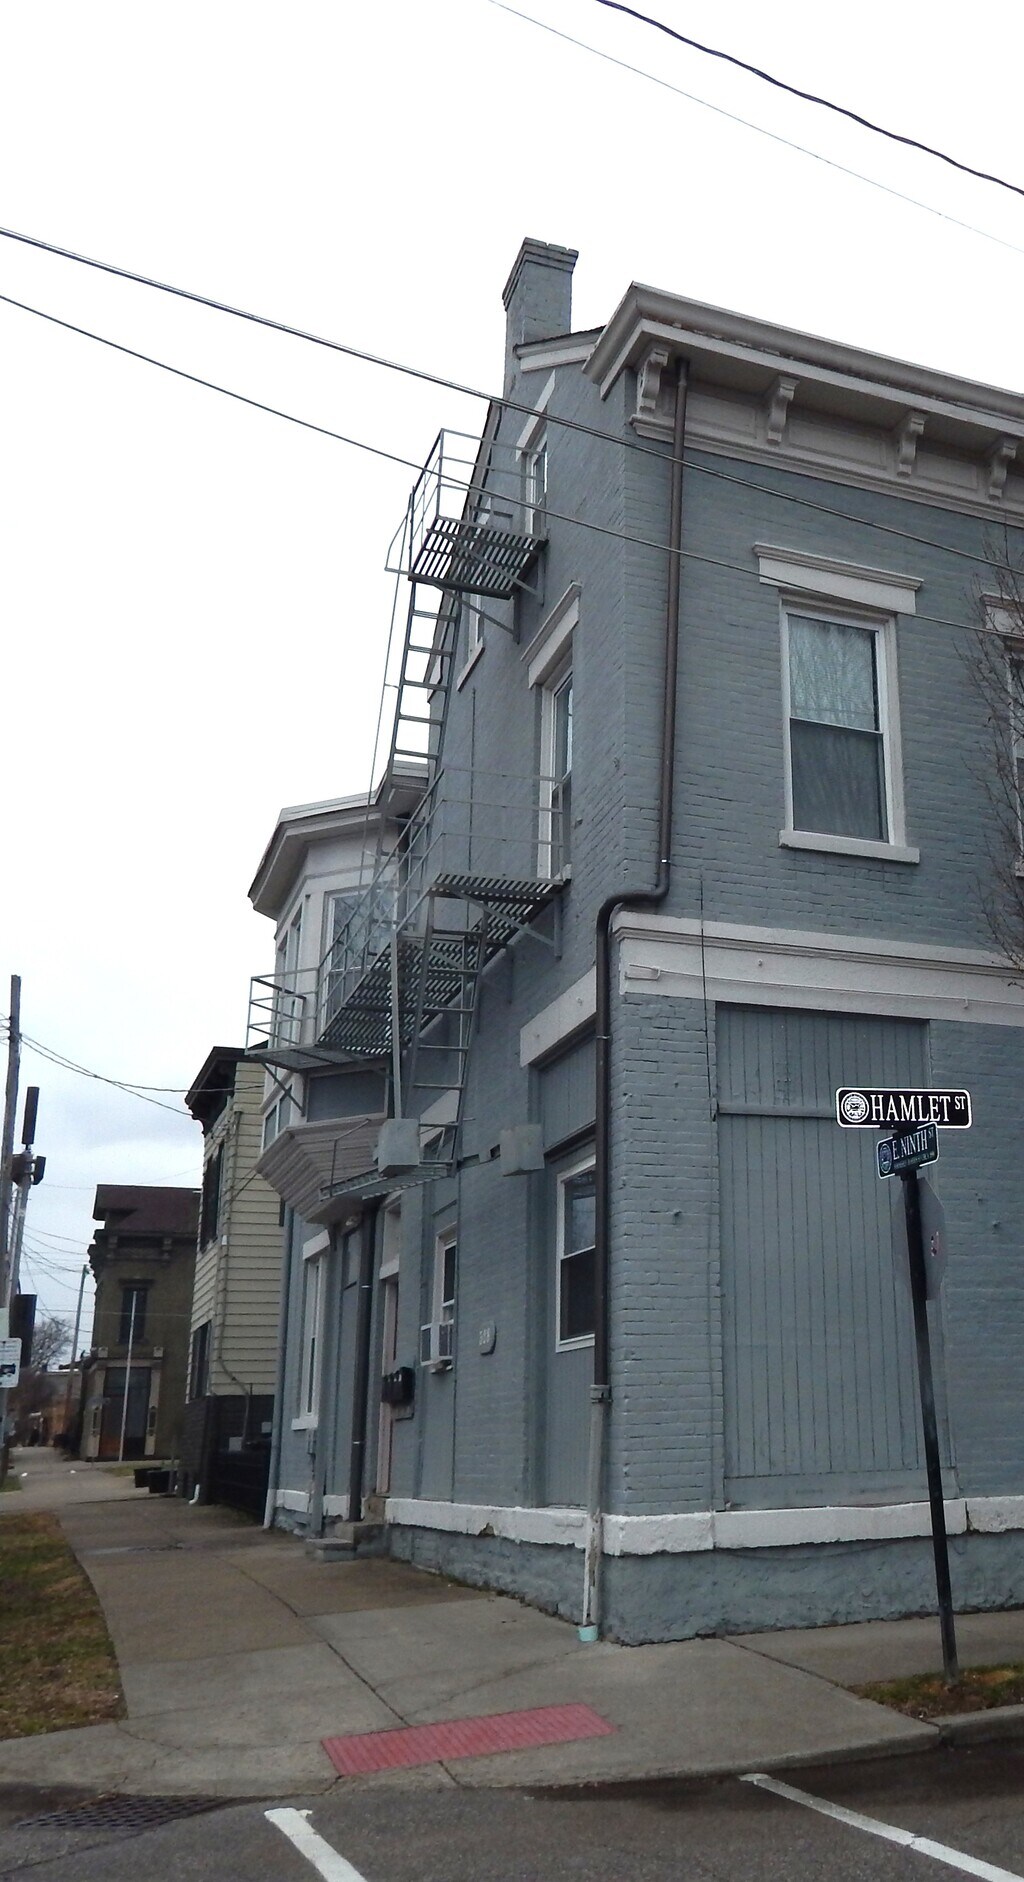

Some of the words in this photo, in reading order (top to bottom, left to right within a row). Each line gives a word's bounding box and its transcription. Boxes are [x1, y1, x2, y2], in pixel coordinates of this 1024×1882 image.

[870, 1094, 951, 1122] HAMLET
[954, 1096, 966, 1110] ST
[900, 1129, 928, 1158] NINTH
[928, 1127, 934, 1139] ST
